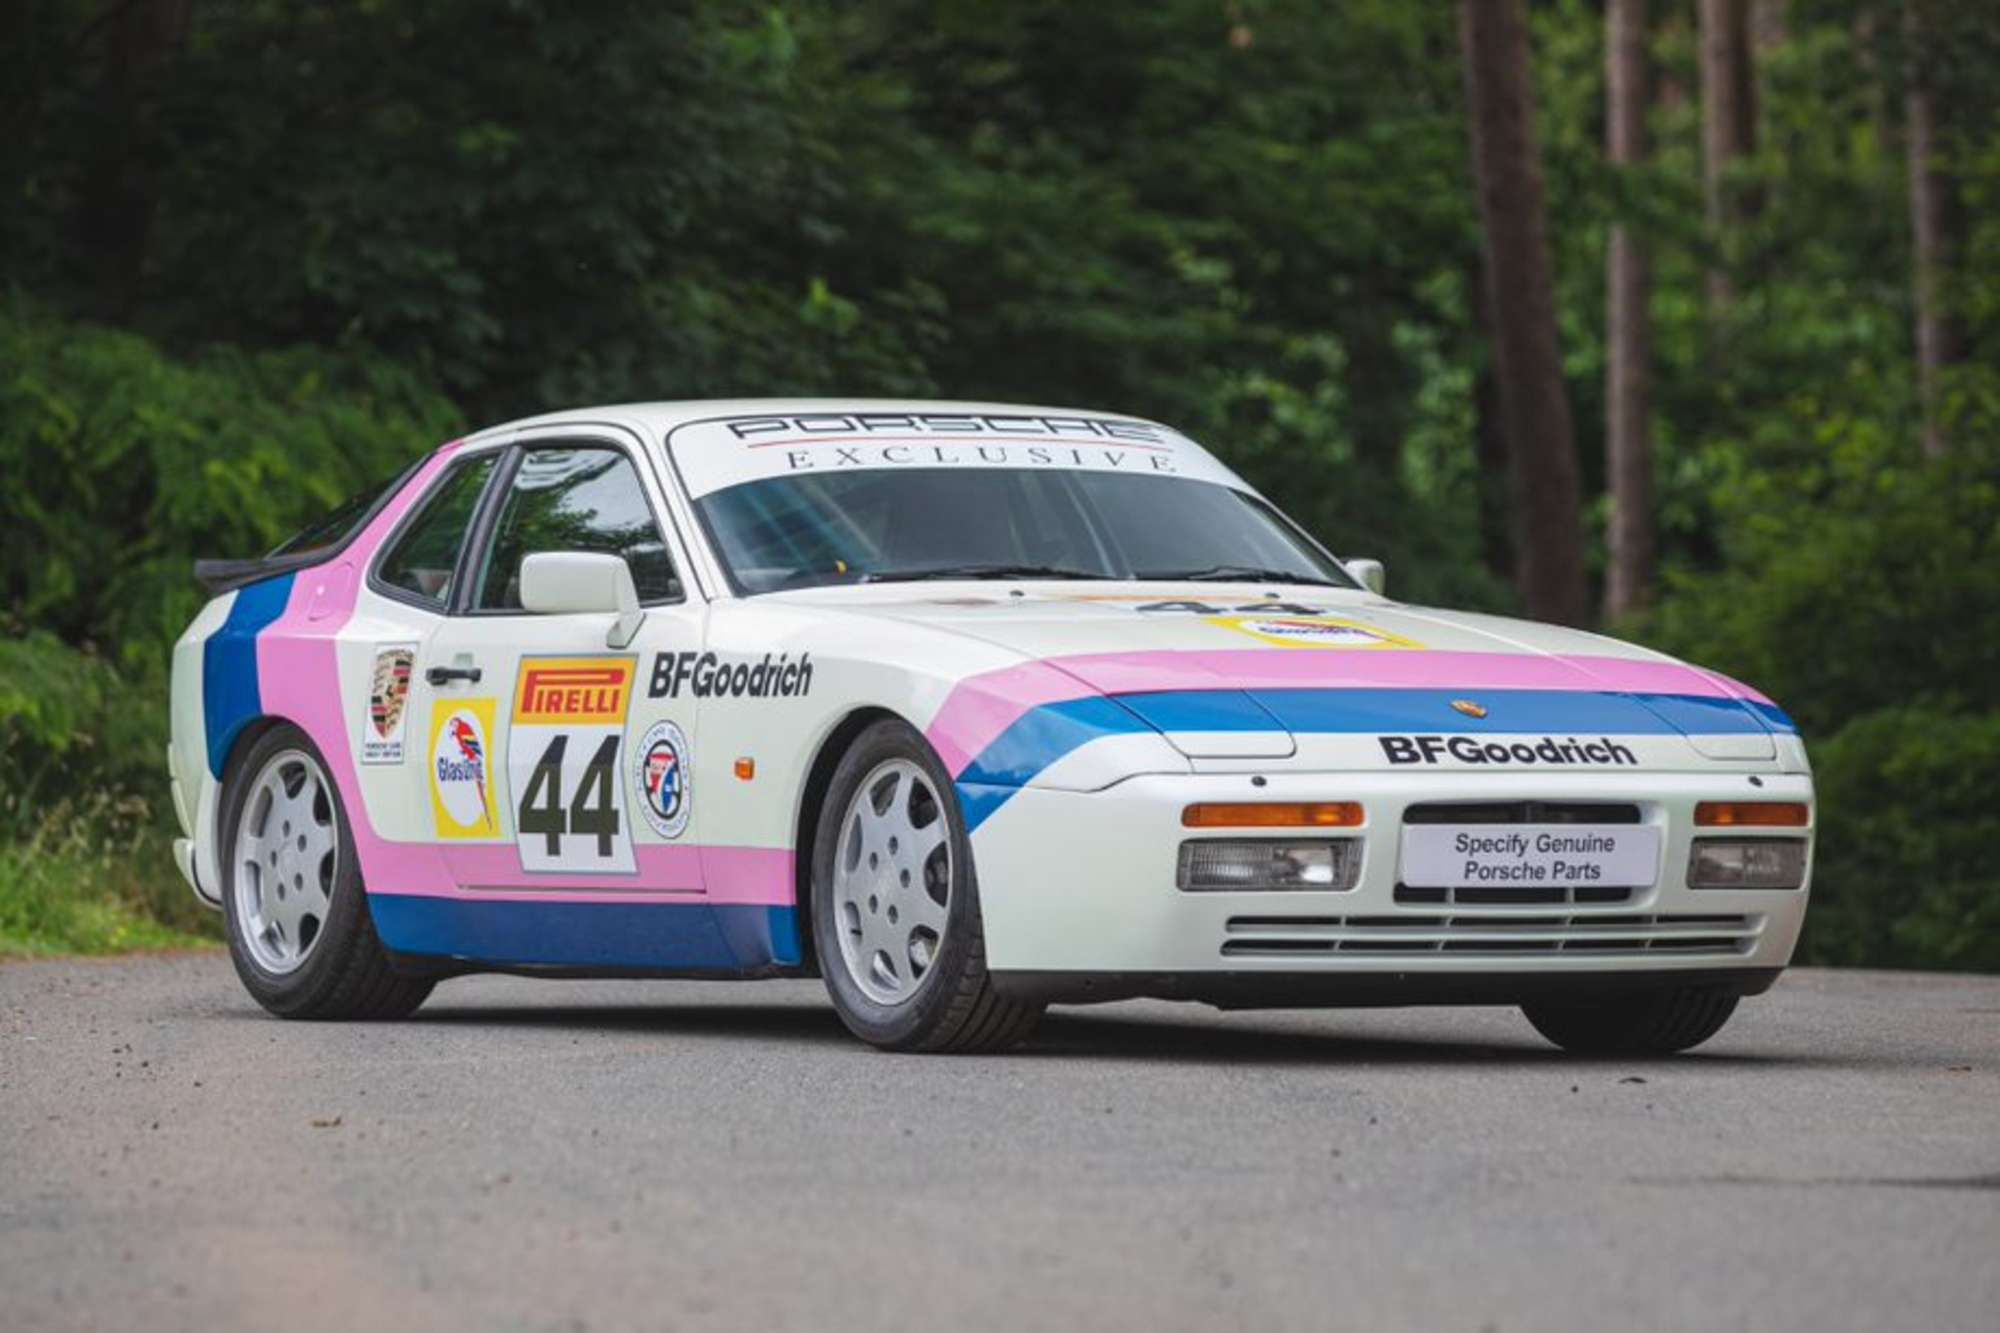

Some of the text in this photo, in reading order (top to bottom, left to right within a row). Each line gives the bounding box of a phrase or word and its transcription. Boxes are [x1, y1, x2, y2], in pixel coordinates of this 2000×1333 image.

[727, 415, 1165, 444] PORSCHE
[788, 446, 1176, 473] EXCLUSIVE
[648, 652, 814, 698] BFGoodrich
[521, 668, 625, 713] PIRELLI
[1378, 736, 1638, 765] BFGoodrich
[519, 735, 621, 857] 44
[1455, 833, 1616, 857] Specify Genuine
[1464, 861, 1601, 880] Porsche Parts
